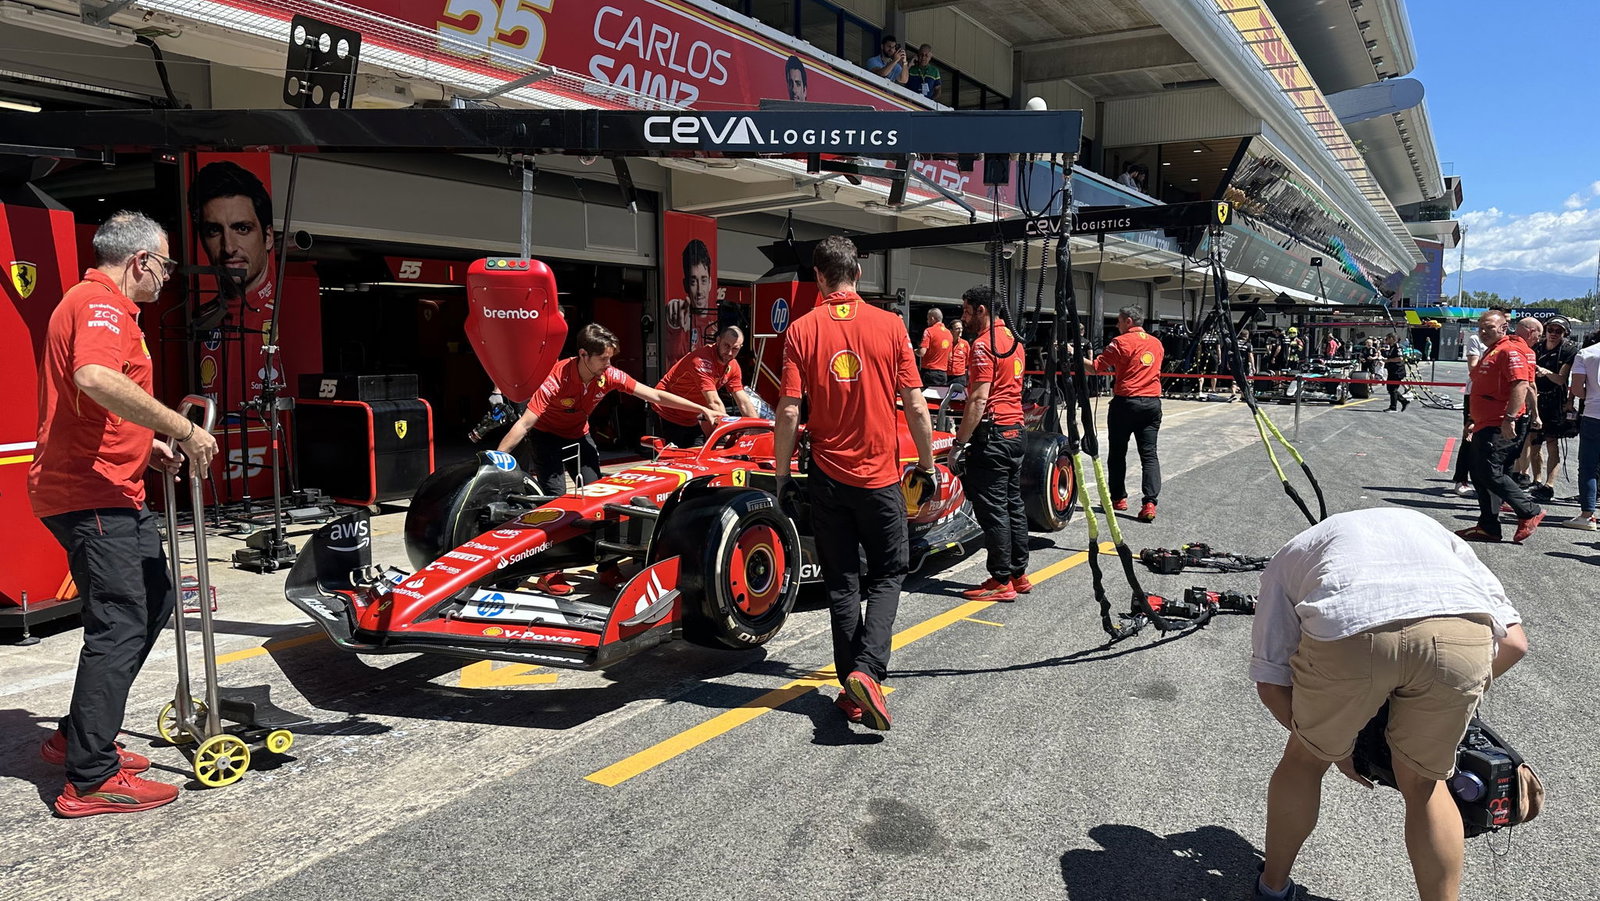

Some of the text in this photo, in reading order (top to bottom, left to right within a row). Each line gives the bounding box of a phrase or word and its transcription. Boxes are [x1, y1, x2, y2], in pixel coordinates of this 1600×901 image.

[436, 0, 547, 73] 55
[593, 5, 732, 86] CARLOS
[769, 129, 898, 146] LOGISTICS
[1076, 218, 1131, 231] LOGISTICS
[399, 260, 423, 279] 55
[483, 306, 539, 320] brembo
[773, 299, 788, 333] hp
[319, 379, 338, 398] 55
[222, 446, 267, 480] 55
[330, 520, 369, 540] aws
[509, 540, 554, 564] Santander
[478, 593, 505, 617] hp
[505, 630, 581, 643] V-Power
